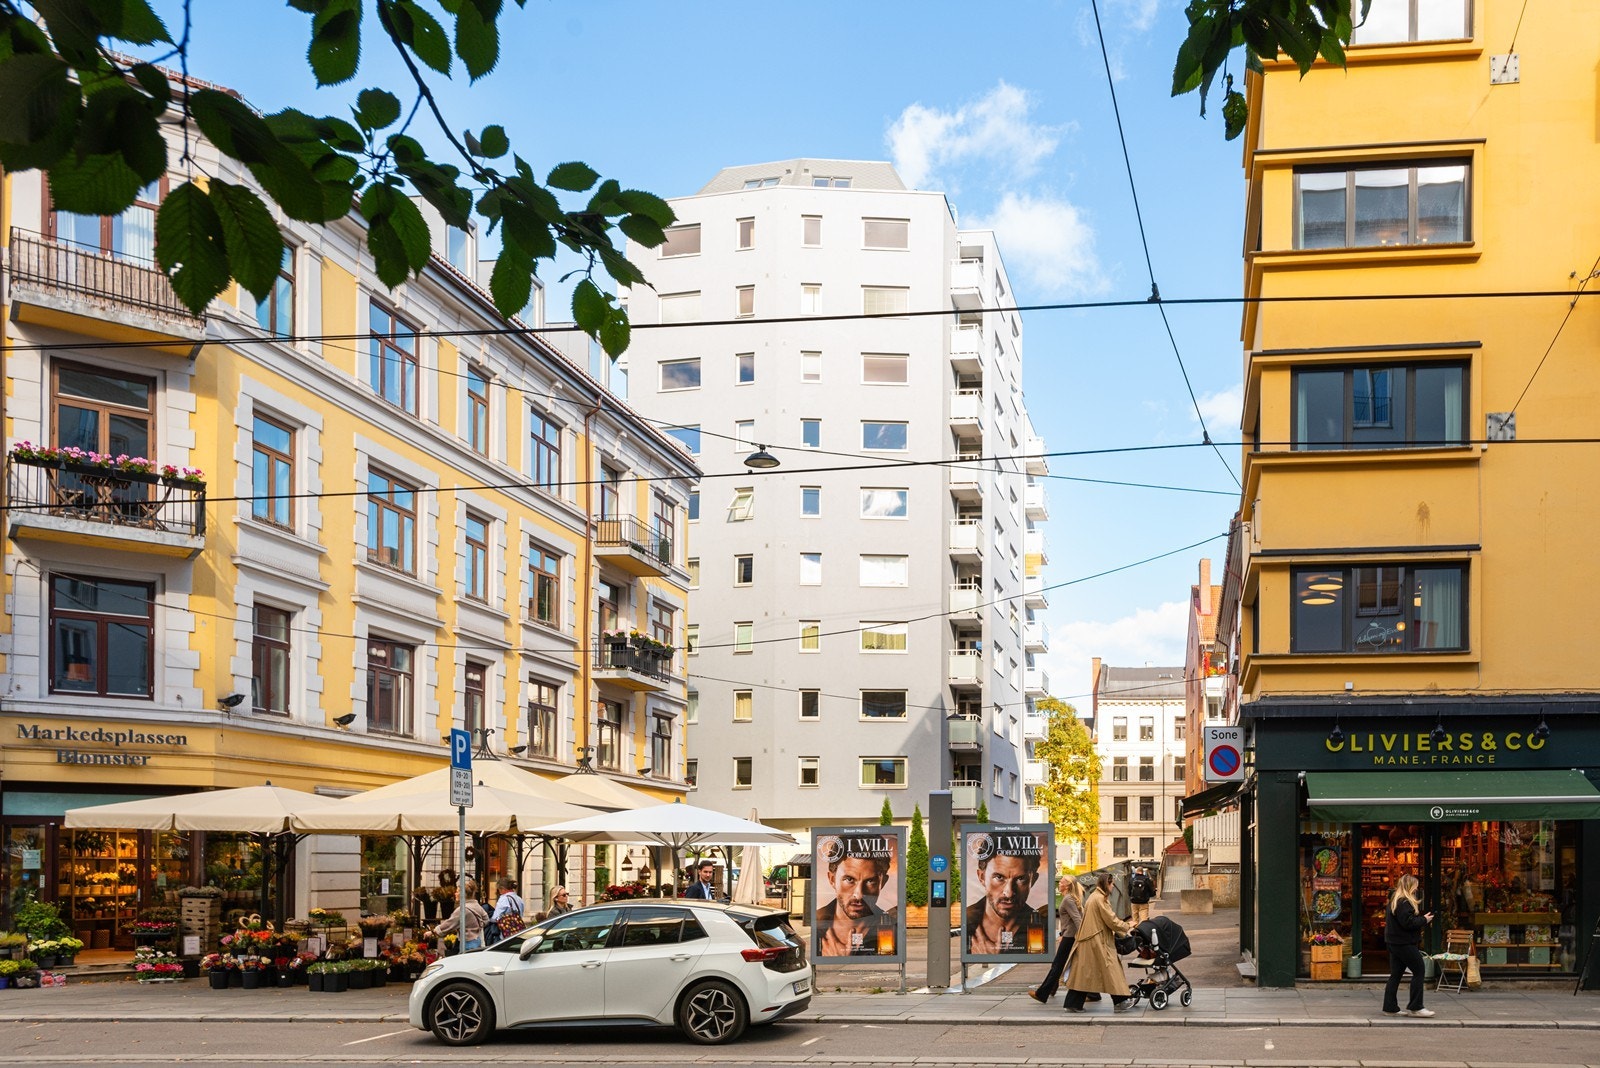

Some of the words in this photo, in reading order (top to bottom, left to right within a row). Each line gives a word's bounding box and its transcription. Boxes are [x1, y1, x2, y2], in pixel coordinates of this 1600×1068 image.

[16, 723, 188, 746] Markedsplassen
[1211, 730, 1238, 740] Sone
[456, 734, 467, 763] P
[56, 748, 151, 766] Blomster
[456, 771, 468, 779] 09-20
[847, 838, 852, 852] I
[857, 838, 893, 852] WILL
[997, 836, 1002, 850] I
[1006, 836, 1043, 849] WILL
